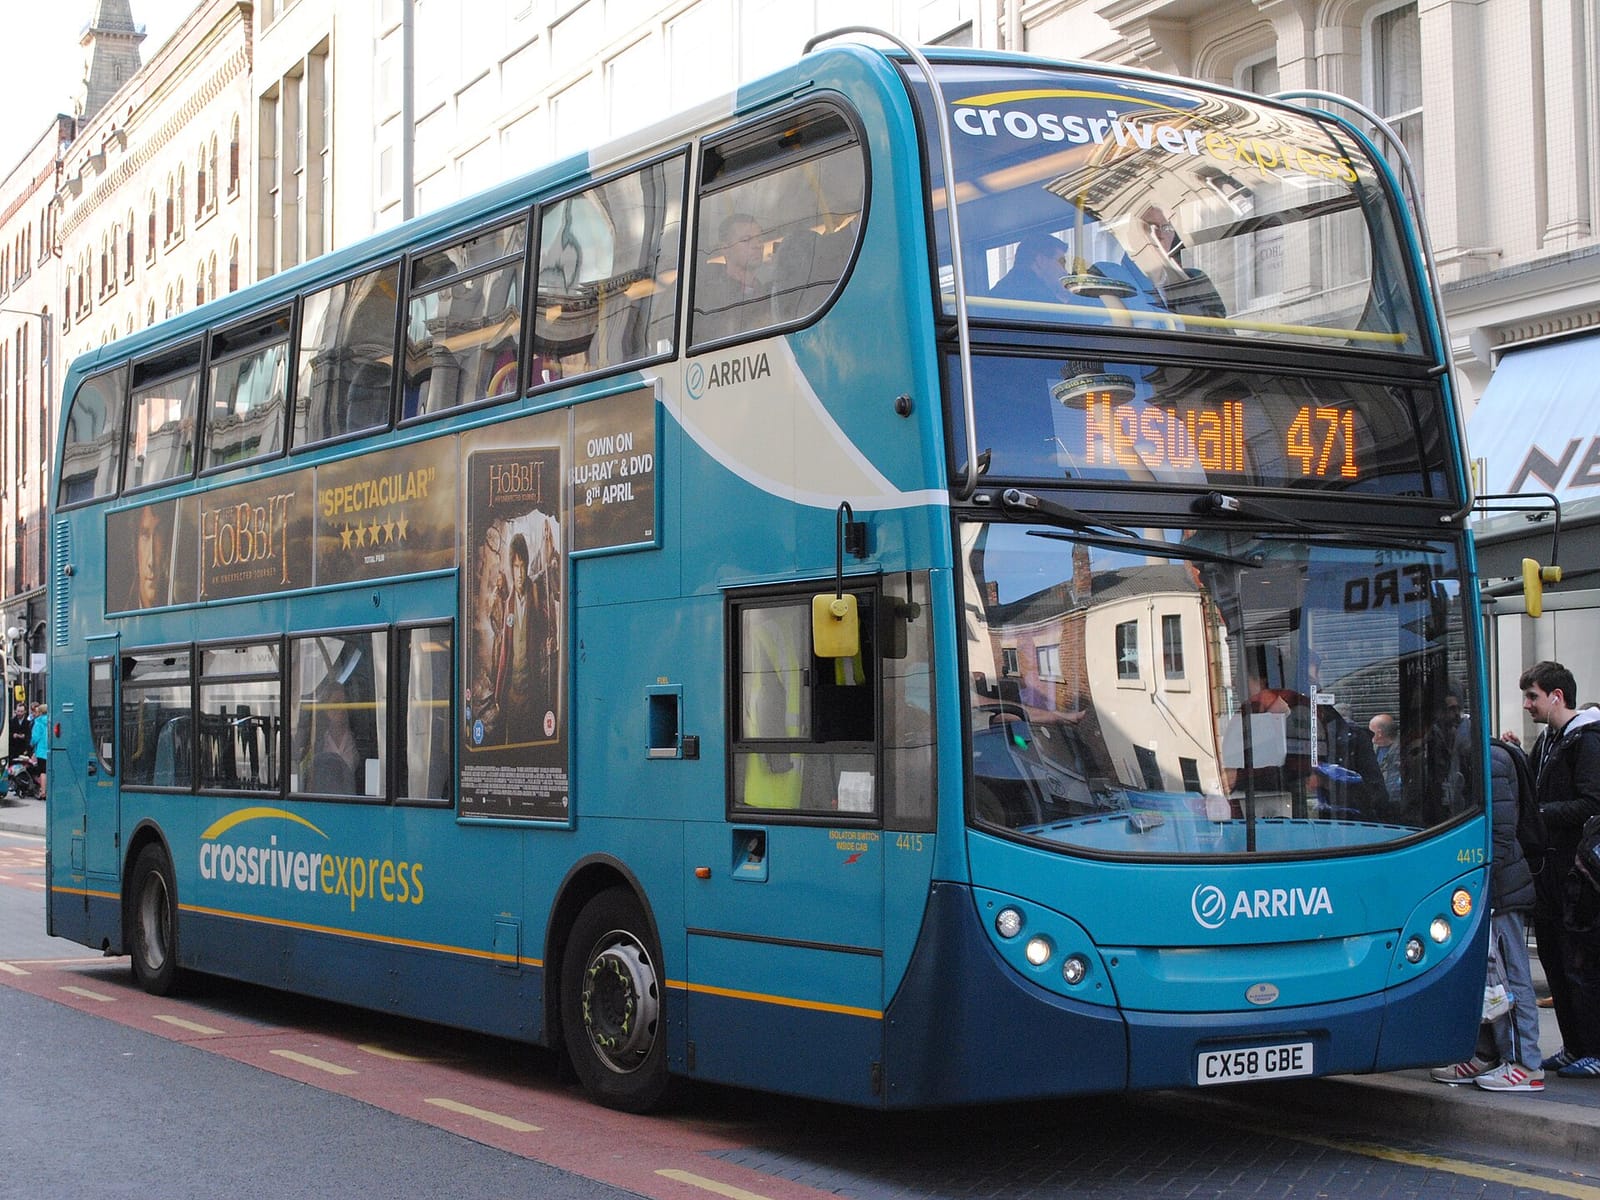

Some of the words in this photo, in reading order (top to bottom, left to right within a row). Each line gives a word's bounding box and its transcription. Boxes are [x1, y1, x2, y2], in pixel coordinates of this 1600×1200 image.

[708, 353, 771, 389] ARRIVA
[587, 436, 614, 458] OWN
[616, 432, 633, 453] ON
[1086, 392, 1244, 472] Heswall
[1287, 405, 1359, 479] 471
[620, 458, 629, 477] &
[630, 453, 653, 475] DVD
[488, 461, 545, 508] HOBBIT
[586, 486, 601, 507] 8TH
[602, 482, 634, 505] APRIL
[200, 491, 296, 596] HOBBIT
[896, 834, 923, 852] 4415
[1456, 848, 1484, 864] 4415
[1230, 887, 1334, 919] ARRIVA
[1205, 1051, 1259, 1079] CX58
[1265, 1046, 1304, 1073] GBE
